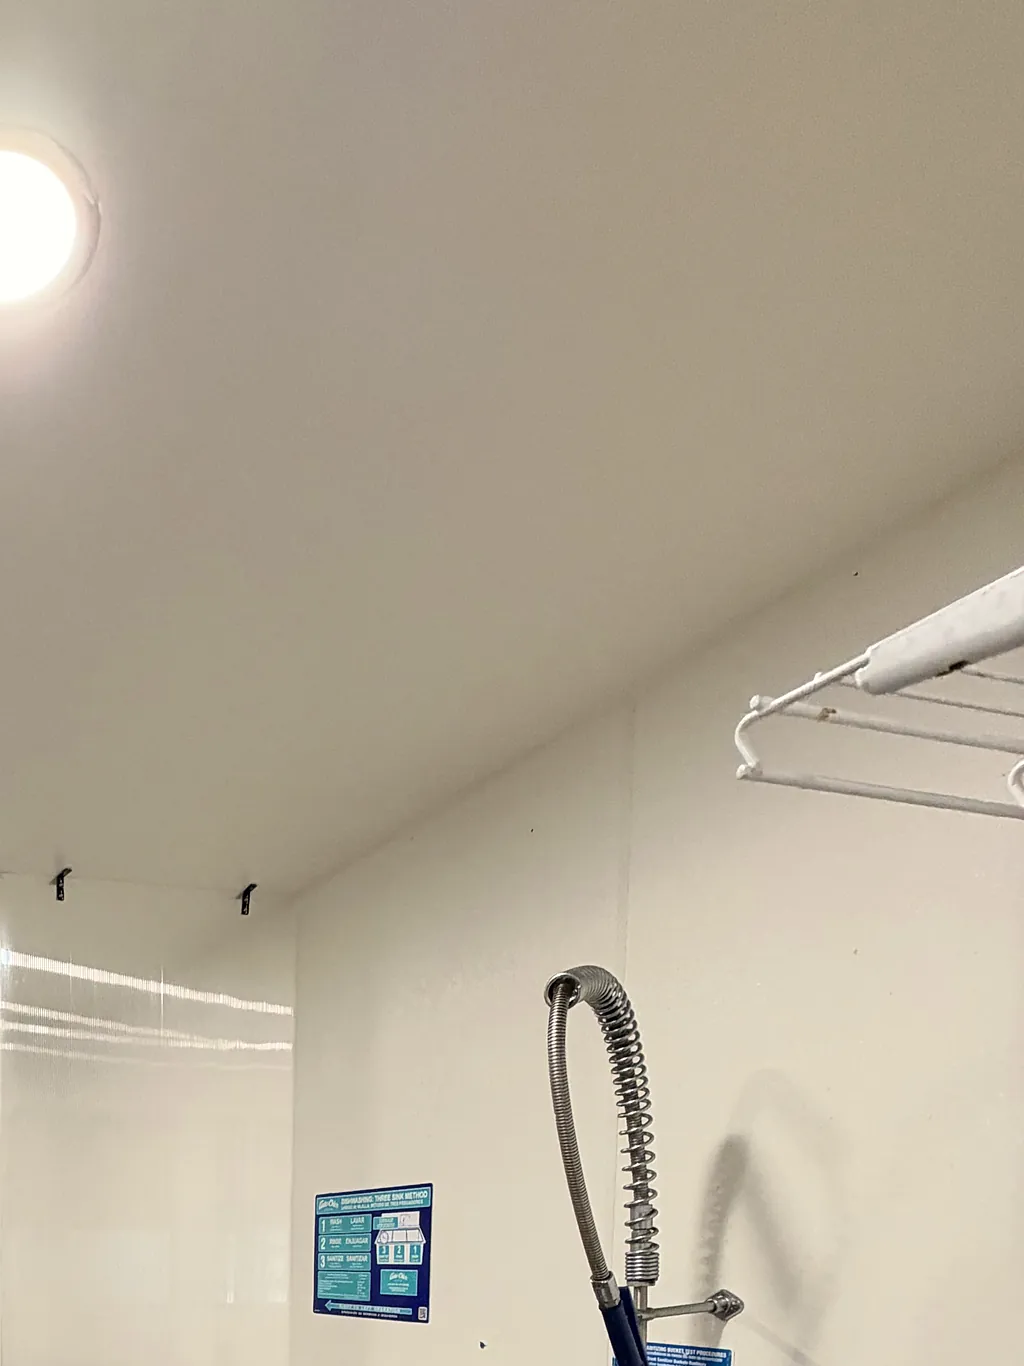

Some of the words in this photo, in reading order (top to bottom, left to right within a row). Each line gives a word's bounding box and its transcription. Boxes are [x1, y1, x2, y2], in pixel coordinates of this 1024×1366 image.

[392, 1191, 404, 1200] SINK
[404, 1190, 428, 1200] METHOD
[321, 1219, 326, 1232] 1
[321, 1237, 326, 1250] 2
[320, 1255, 326, 1268] 3
